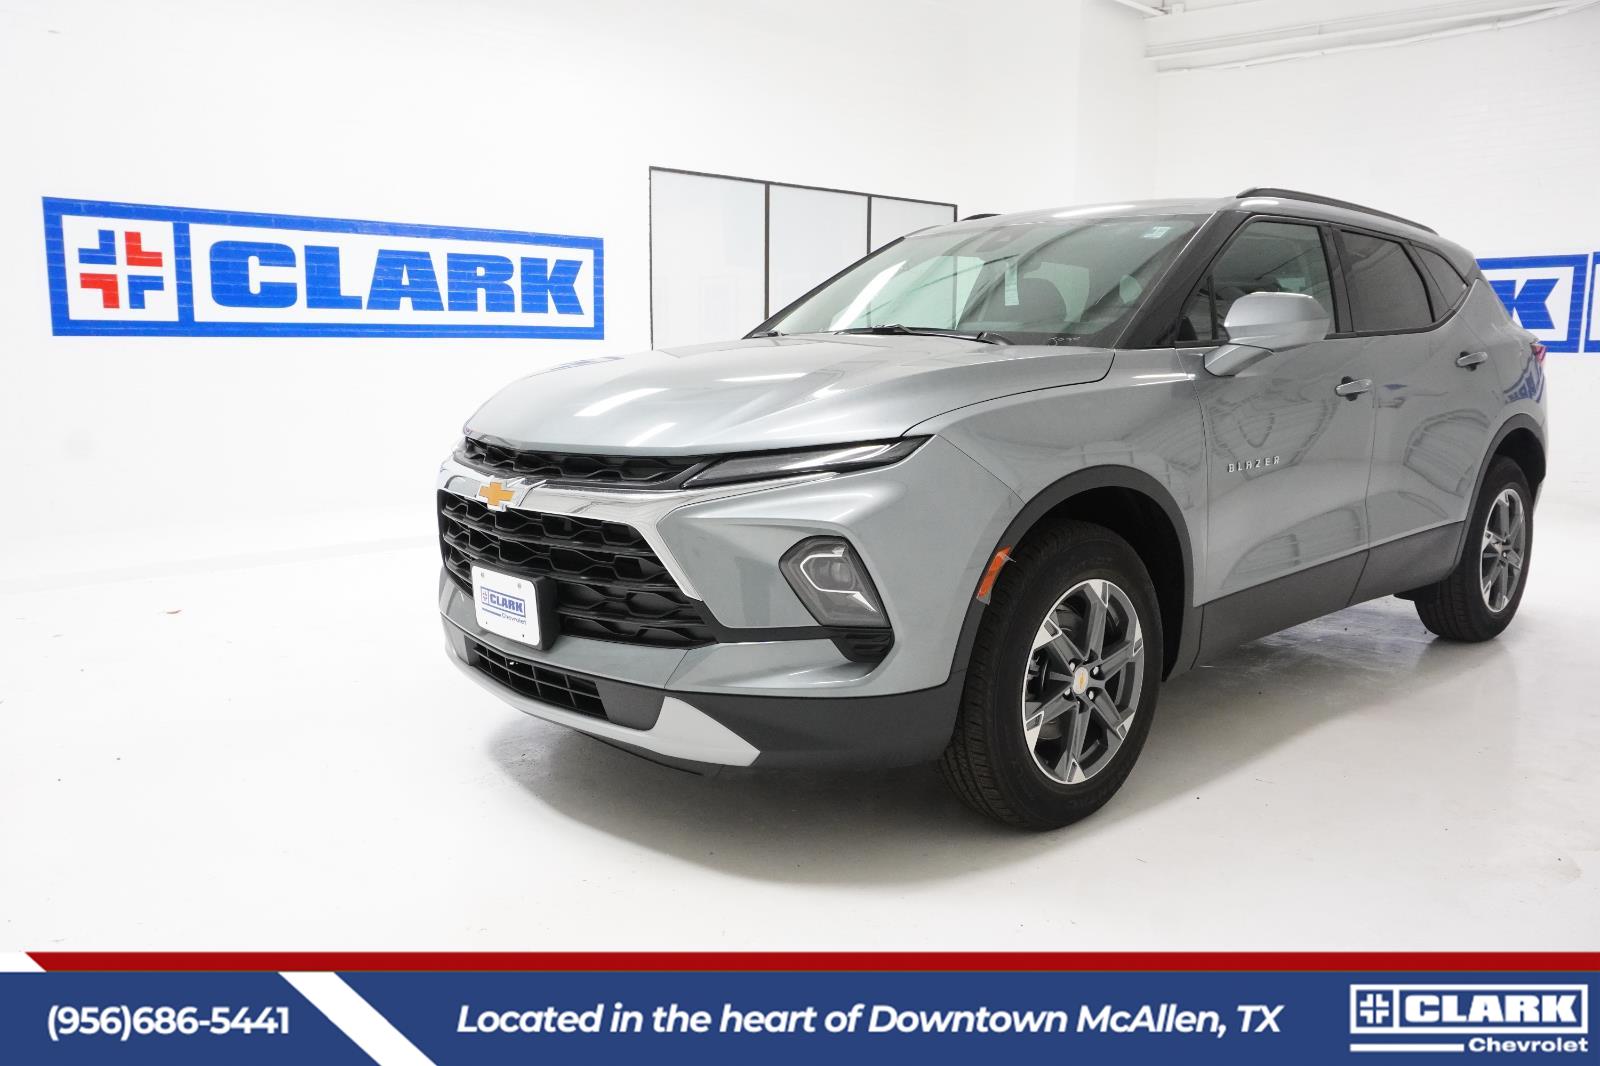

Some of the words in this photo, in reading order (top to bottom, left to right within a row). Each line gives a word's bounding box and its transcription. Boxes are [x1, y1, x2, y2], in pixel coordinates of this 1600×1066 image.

[208, 239, 584, 316] CLARK
[1227, 456, 1280, 473] BLAZER
[489, 594, 524, 613] CLARK
